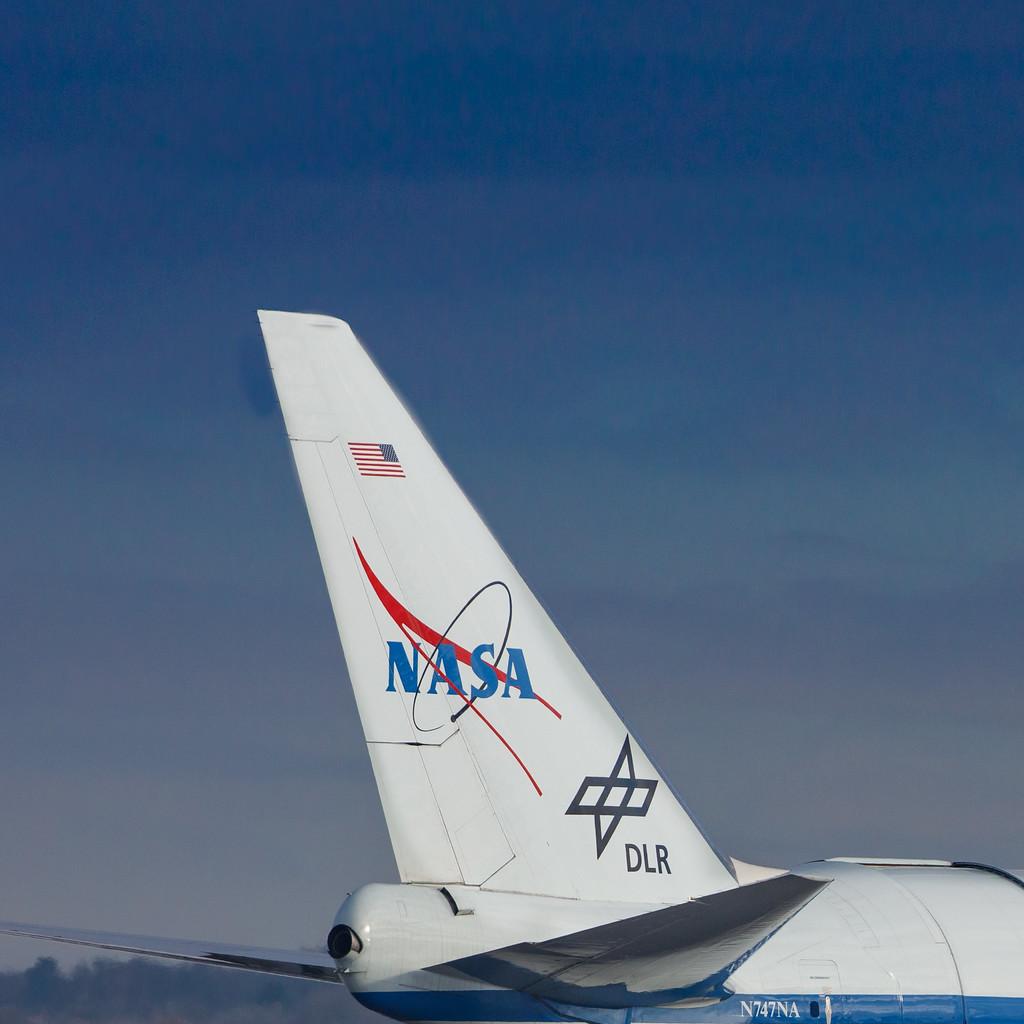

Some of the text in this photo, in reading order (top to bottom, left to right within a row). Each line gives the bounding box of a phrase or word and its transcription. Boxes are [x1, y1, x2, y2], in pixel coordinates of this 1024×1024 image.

[385, 640, 538, 700] NASA
[624, 843, 672, 875] DLR
[740, 1000, 801, 1018] N747NA
